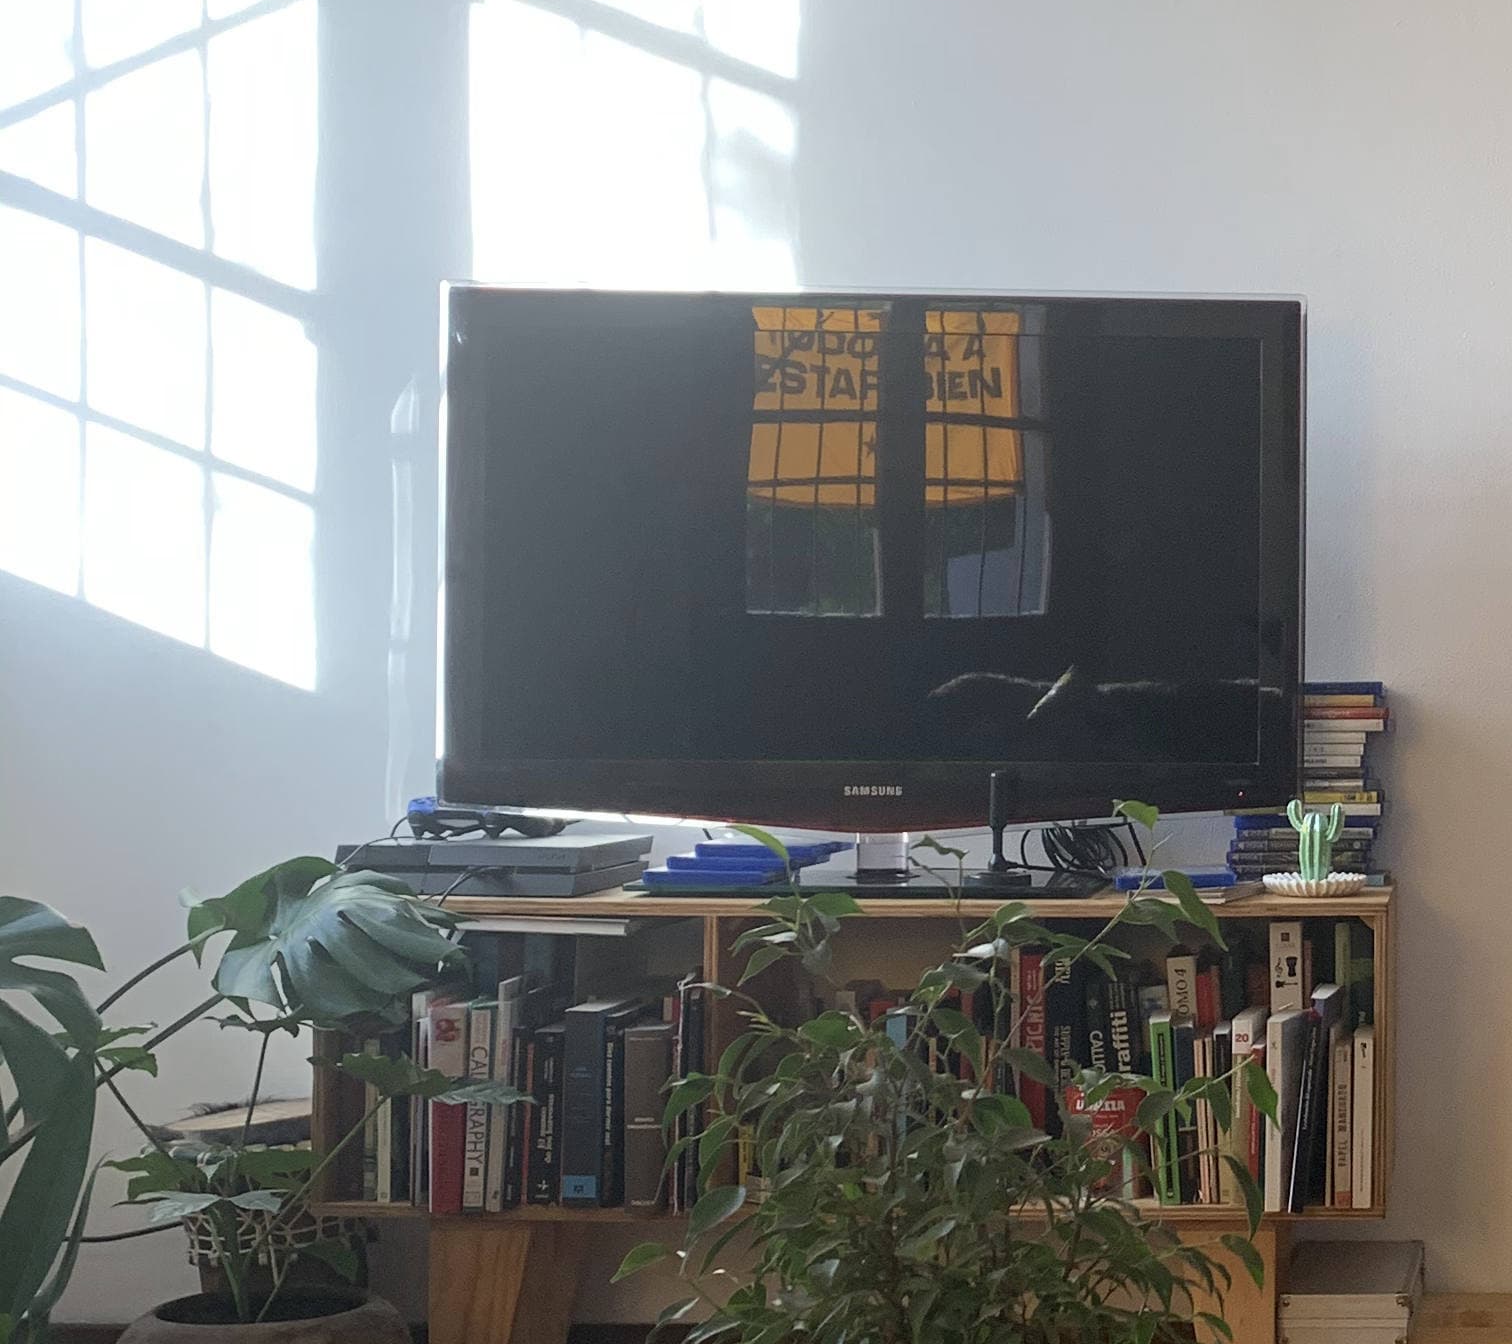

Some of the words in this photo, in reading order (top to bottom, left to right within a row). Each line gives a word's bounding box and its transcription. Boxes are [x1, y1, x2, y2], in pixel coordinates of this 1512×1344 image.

[844, 785, 903, 797] SAMSUNG
[1109, 1010, 1132, 1073] raffiti
[1235, 1032, 1249, 1044] 20
[466, 1046, 489, 1168] CALGRAPHY
